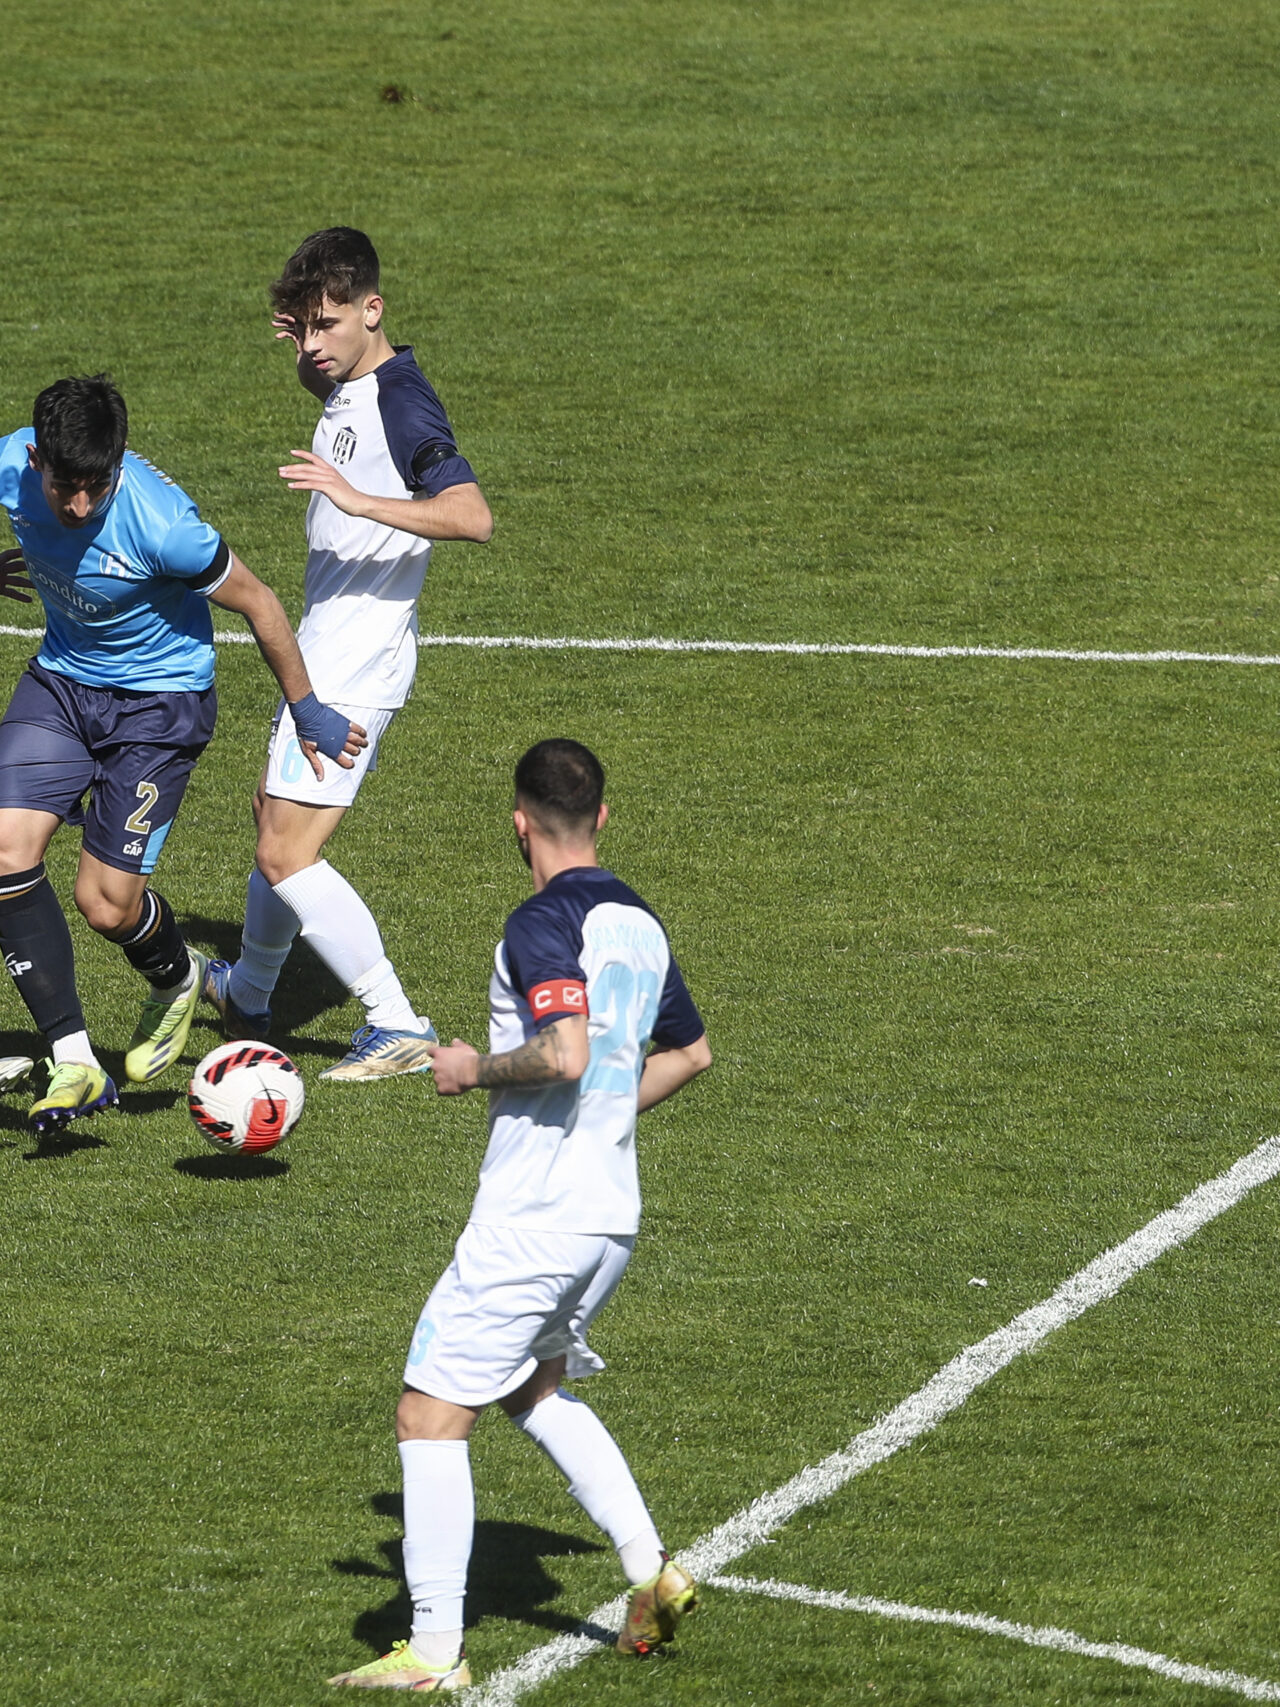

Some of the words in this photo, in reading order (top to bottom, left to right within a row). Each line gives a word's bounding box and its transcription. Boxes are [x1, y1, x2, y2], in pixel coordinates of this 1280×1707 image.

[27, 561, 98, 614] Condito
[280, 738, 305, 784] 6
[124, 781, 159, 835] 2
[123, 843, 143, 857] CAP
[534, 989, 552, 1010] C
